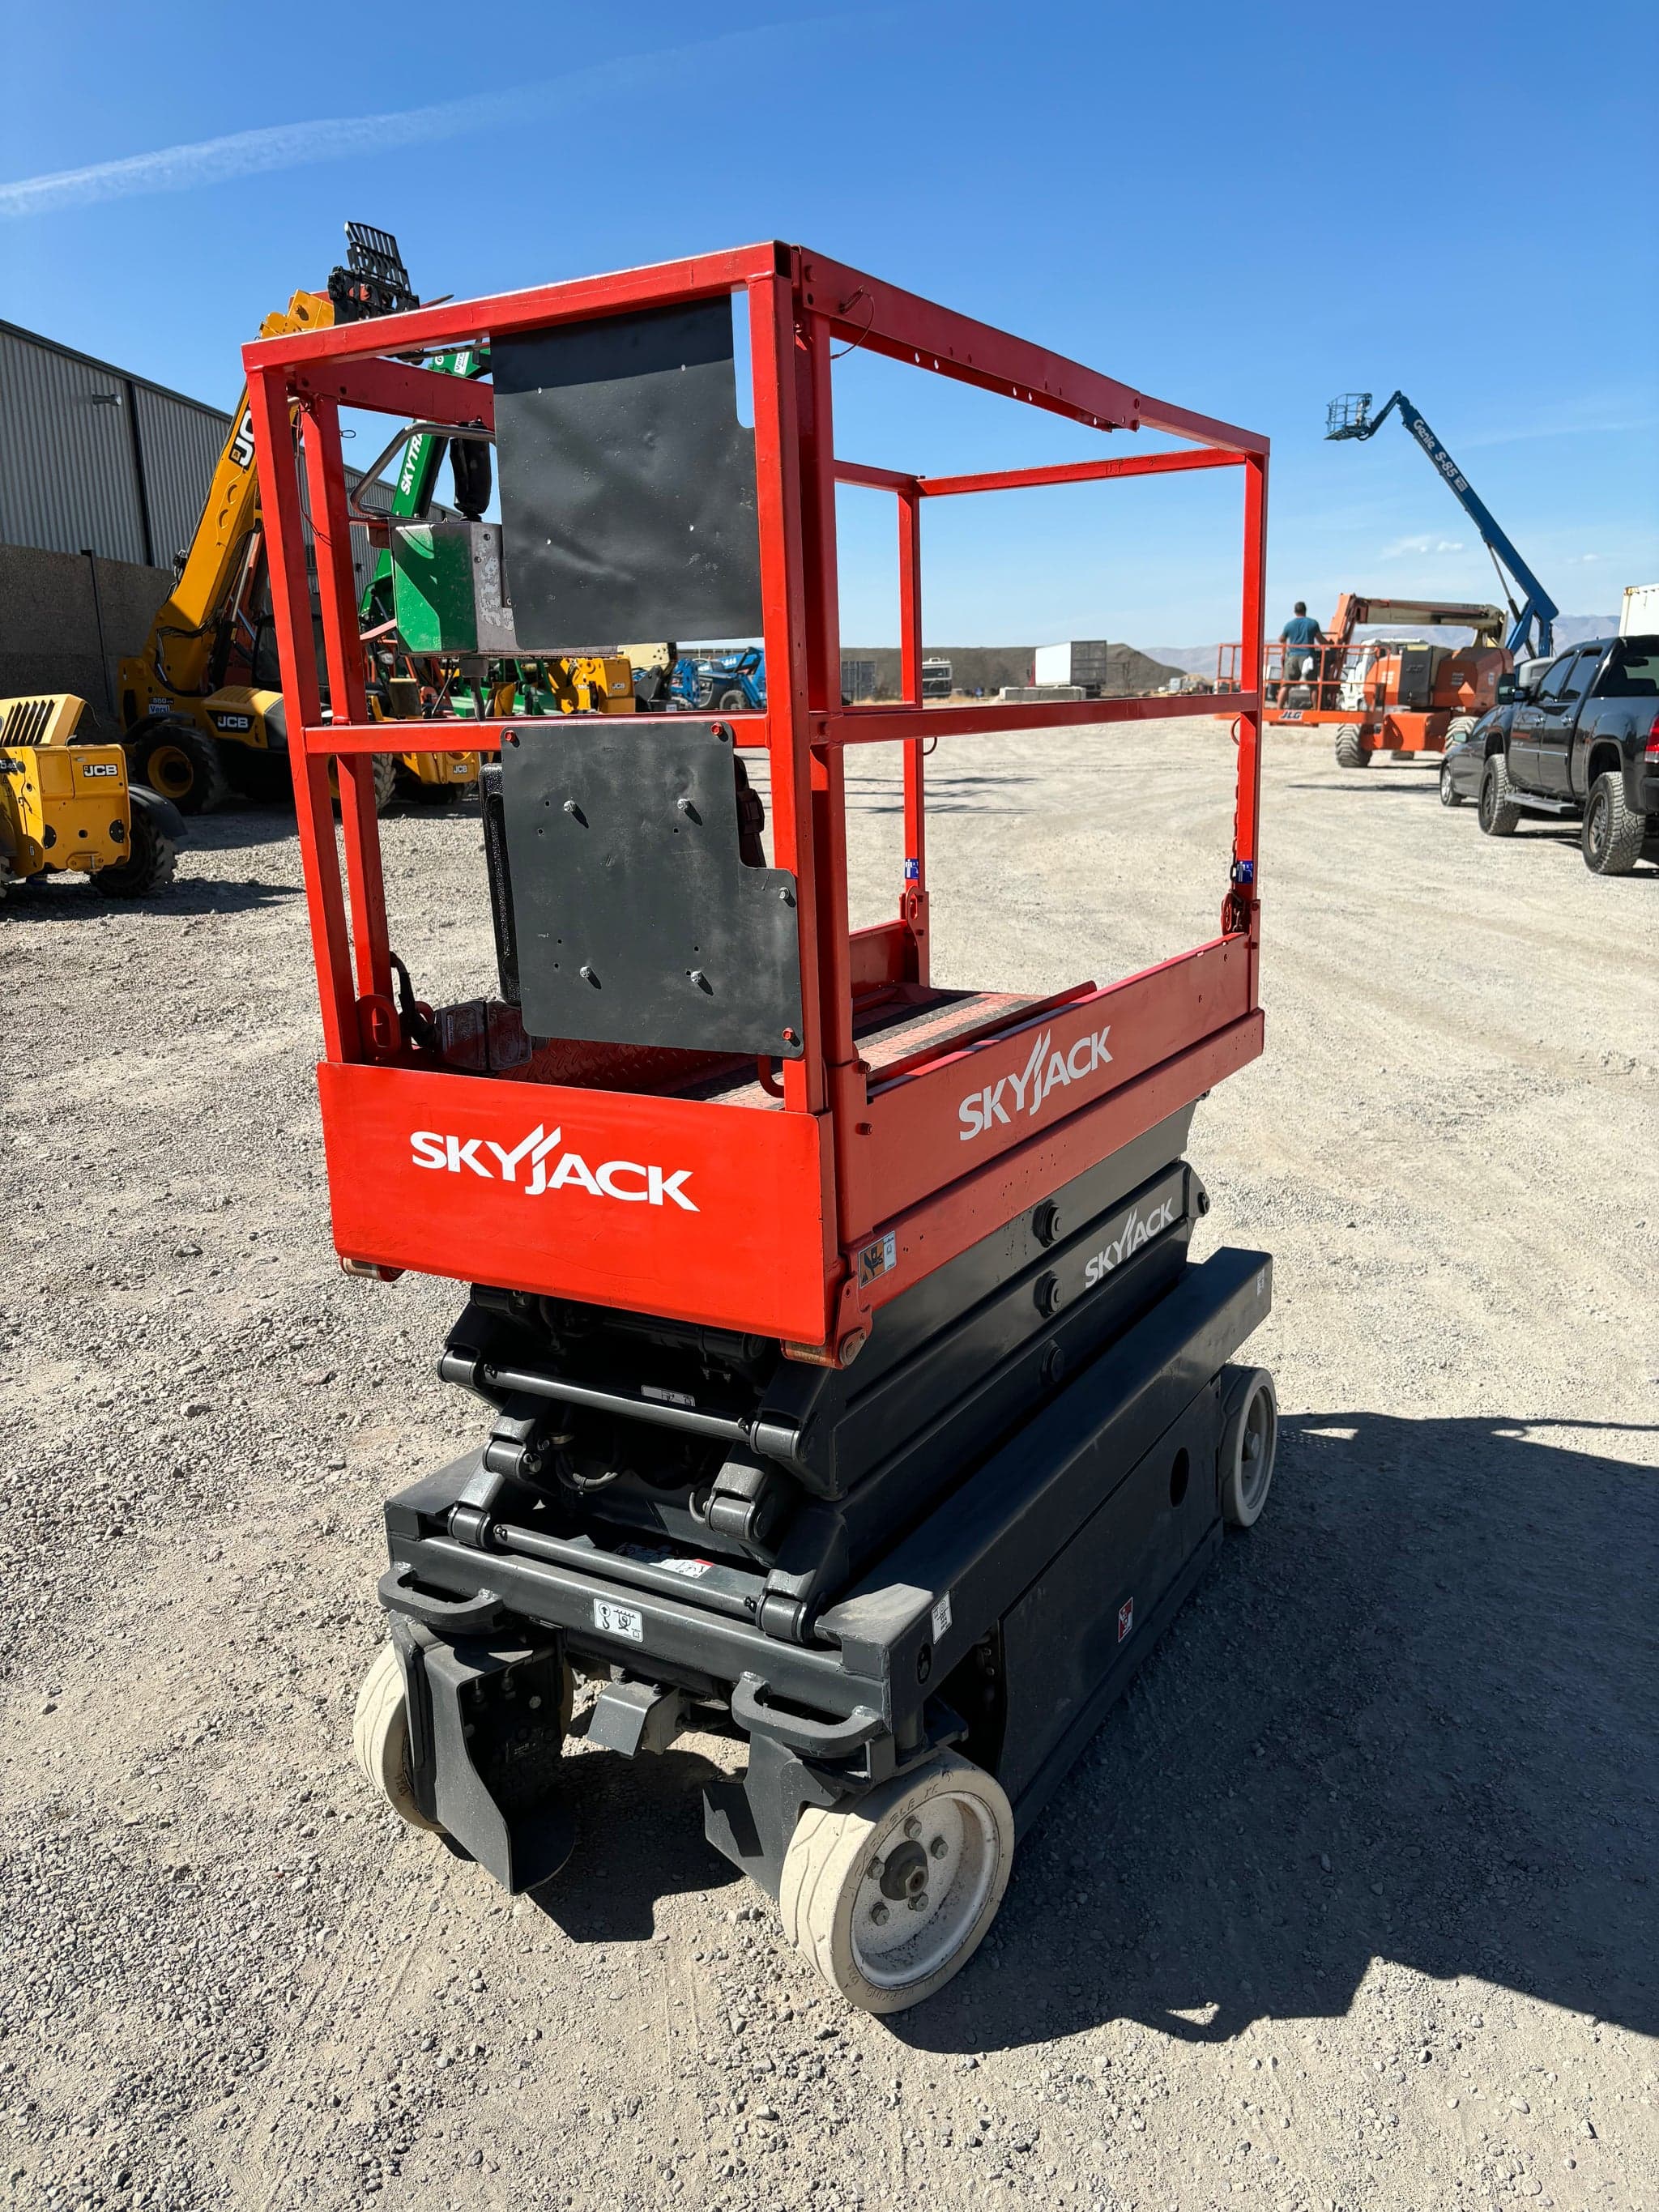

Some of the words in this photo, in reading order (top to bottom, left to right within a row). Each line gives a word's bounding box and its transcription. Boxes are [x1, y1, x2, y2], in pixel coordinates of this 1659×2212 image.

[235, 405, 254, 466] JC
[401, 420, 424, 496] SKYTR
[1413, 419, 1435, 451] Genie
[1435, 451, 1458, 478] S-85
[217, 716, 249, 728] JCB
[83, 765, 117, 777] JCB
[958, 1025, 1114, 1141] SKYJACK
[409, 1123, 701, 1213] SKYJACK
[1085, 1196, 1175, 1289] SKYJACK
